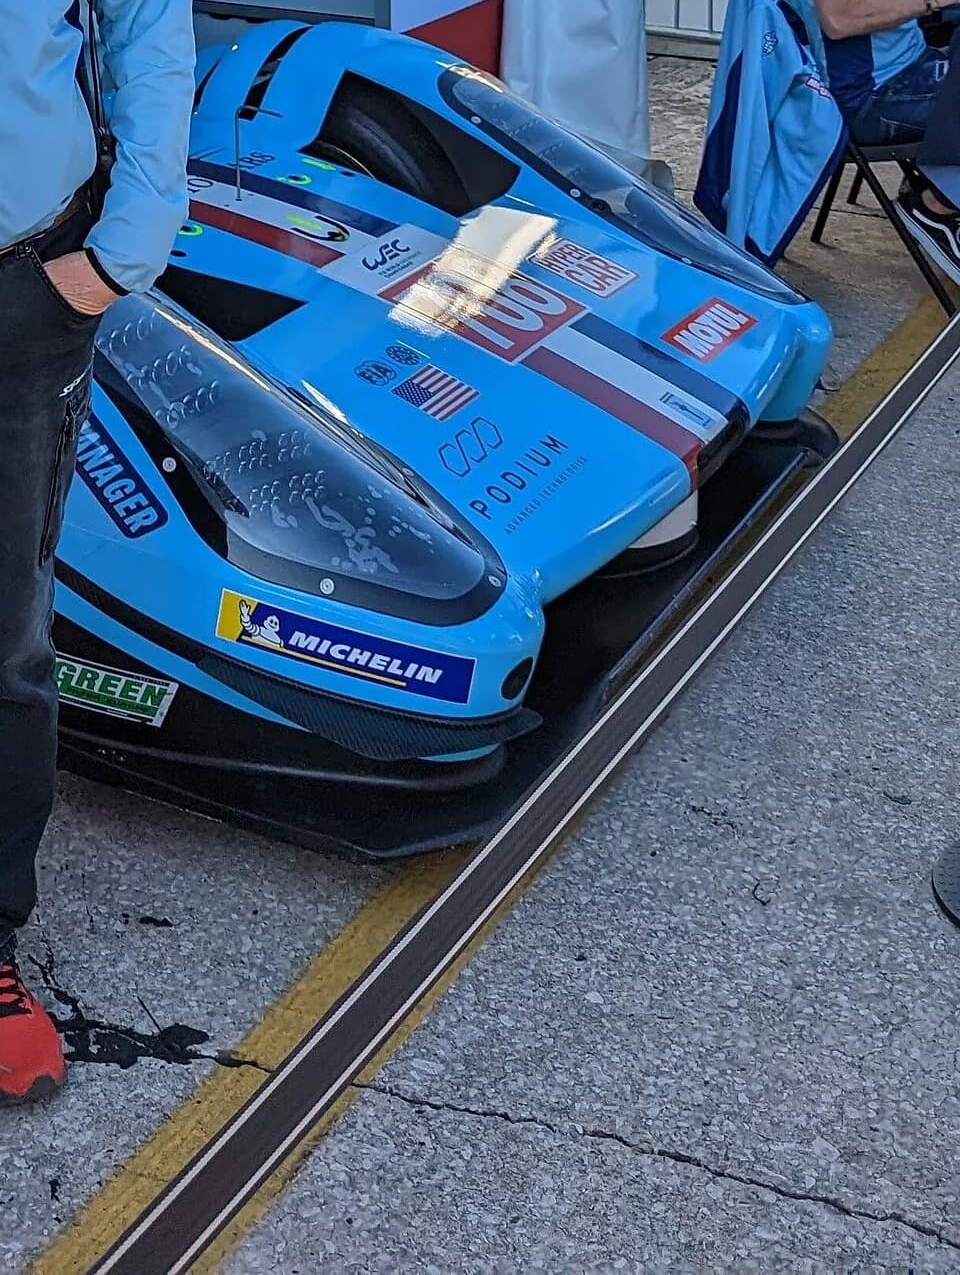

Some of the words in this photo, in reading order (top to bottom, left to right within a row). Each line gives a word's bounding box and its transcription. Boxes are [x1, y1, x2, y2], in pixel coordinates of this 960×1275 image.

[362, 239, 411, 271] WEC
[540, 243, 591, 273] HYPER
[564, 256, 631, 292] CAR
[673, 303, 750, 360] MOTUL
[469, 434, 569, 521] PODIUM
[289, 630, 443, 684] MICHELIN
[52, 661, 168, 707] GREEN
